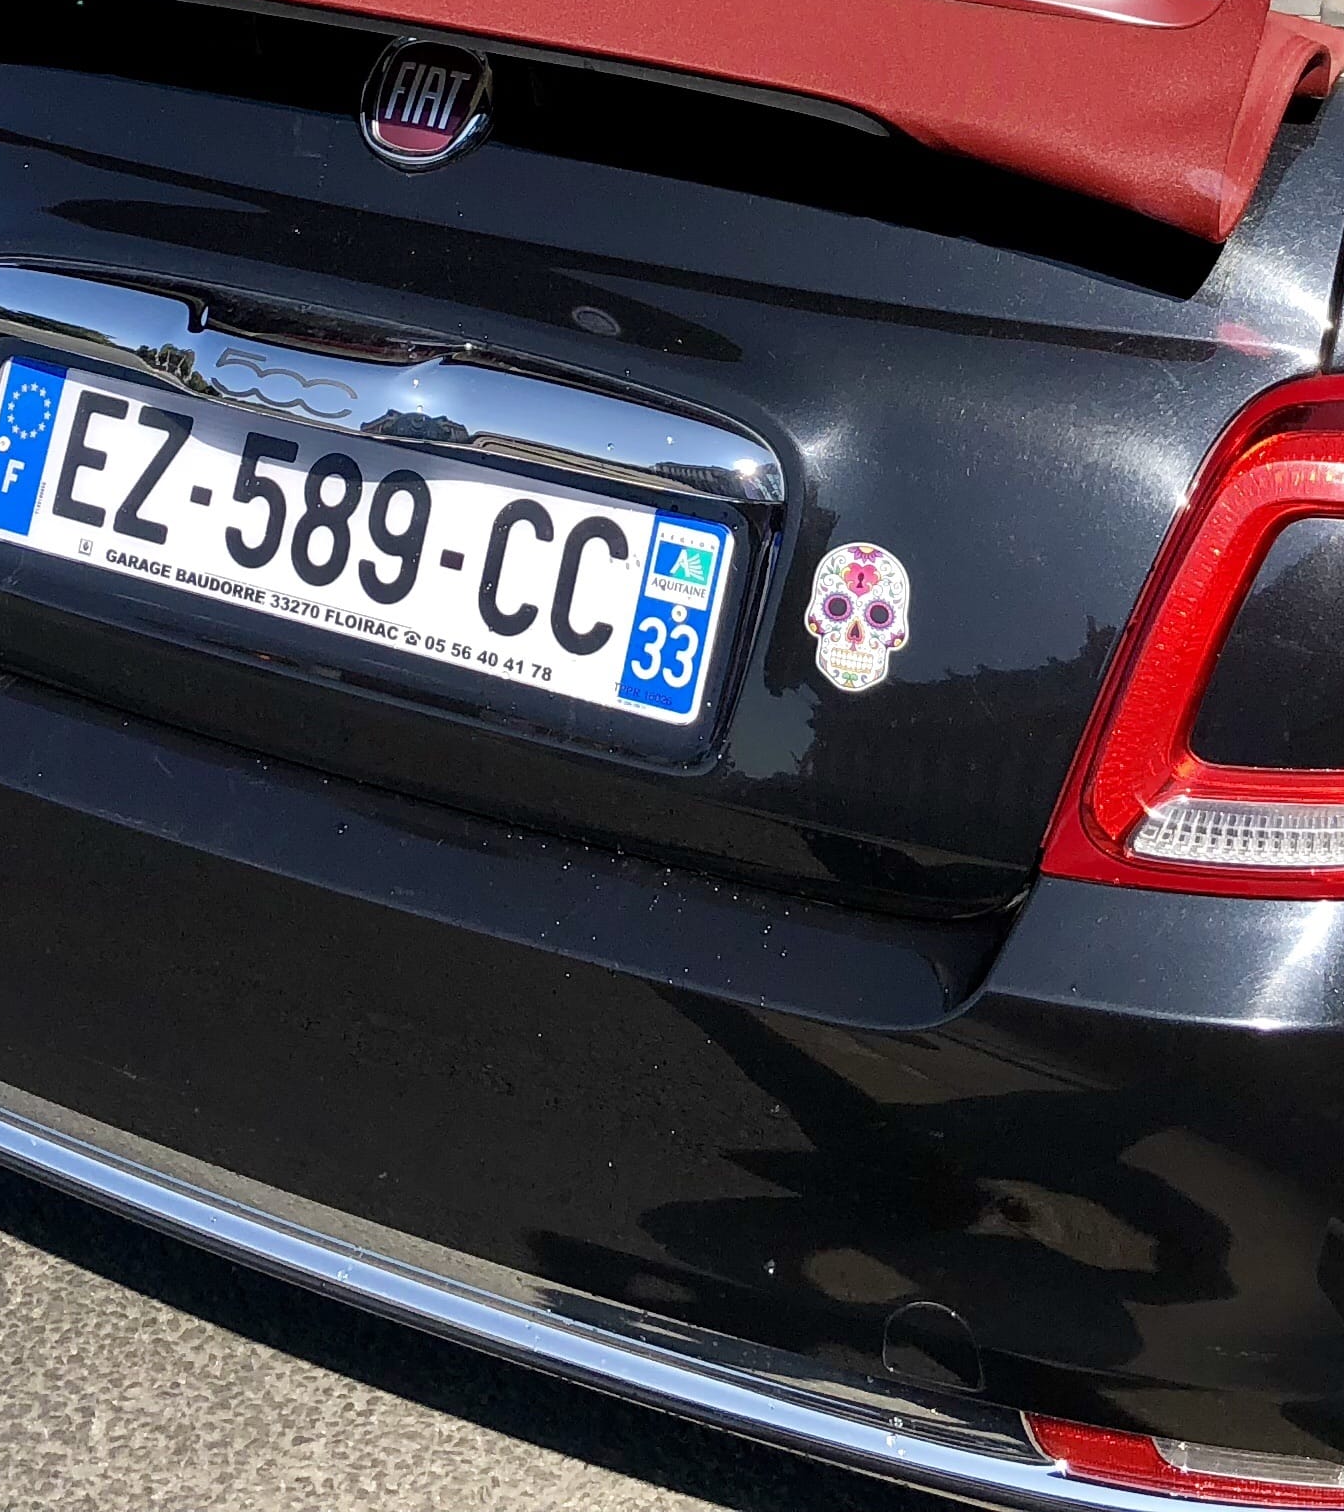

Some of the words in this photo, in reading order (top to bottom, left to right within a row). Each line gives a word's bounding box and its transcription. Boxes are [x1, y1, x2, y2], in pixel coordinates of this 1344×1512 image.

[384, 61, 472, 130] FIAT
[210, 347, 358, 419] 500
[0, 458, 26, 494] F
[52, 390, 630, 657] EZ-589-CC
[105, 548, 173, 579] GARAGE
[175, 568, 267, 605] BAUDORRE
[269, 594, 320, 620] 33270
[324, 609, 400, 641] FLOIRAC
[424, 636, 446, 653] 05
[450, 642, 472, 660] 56
[476, 650, 499, 667] 40
[502, 656, 524, 675] 41
[531, 663, 553, 682] 78
[650, 576, 707, 599] AQUITAINE
[630, 616, 699, 688] 33
